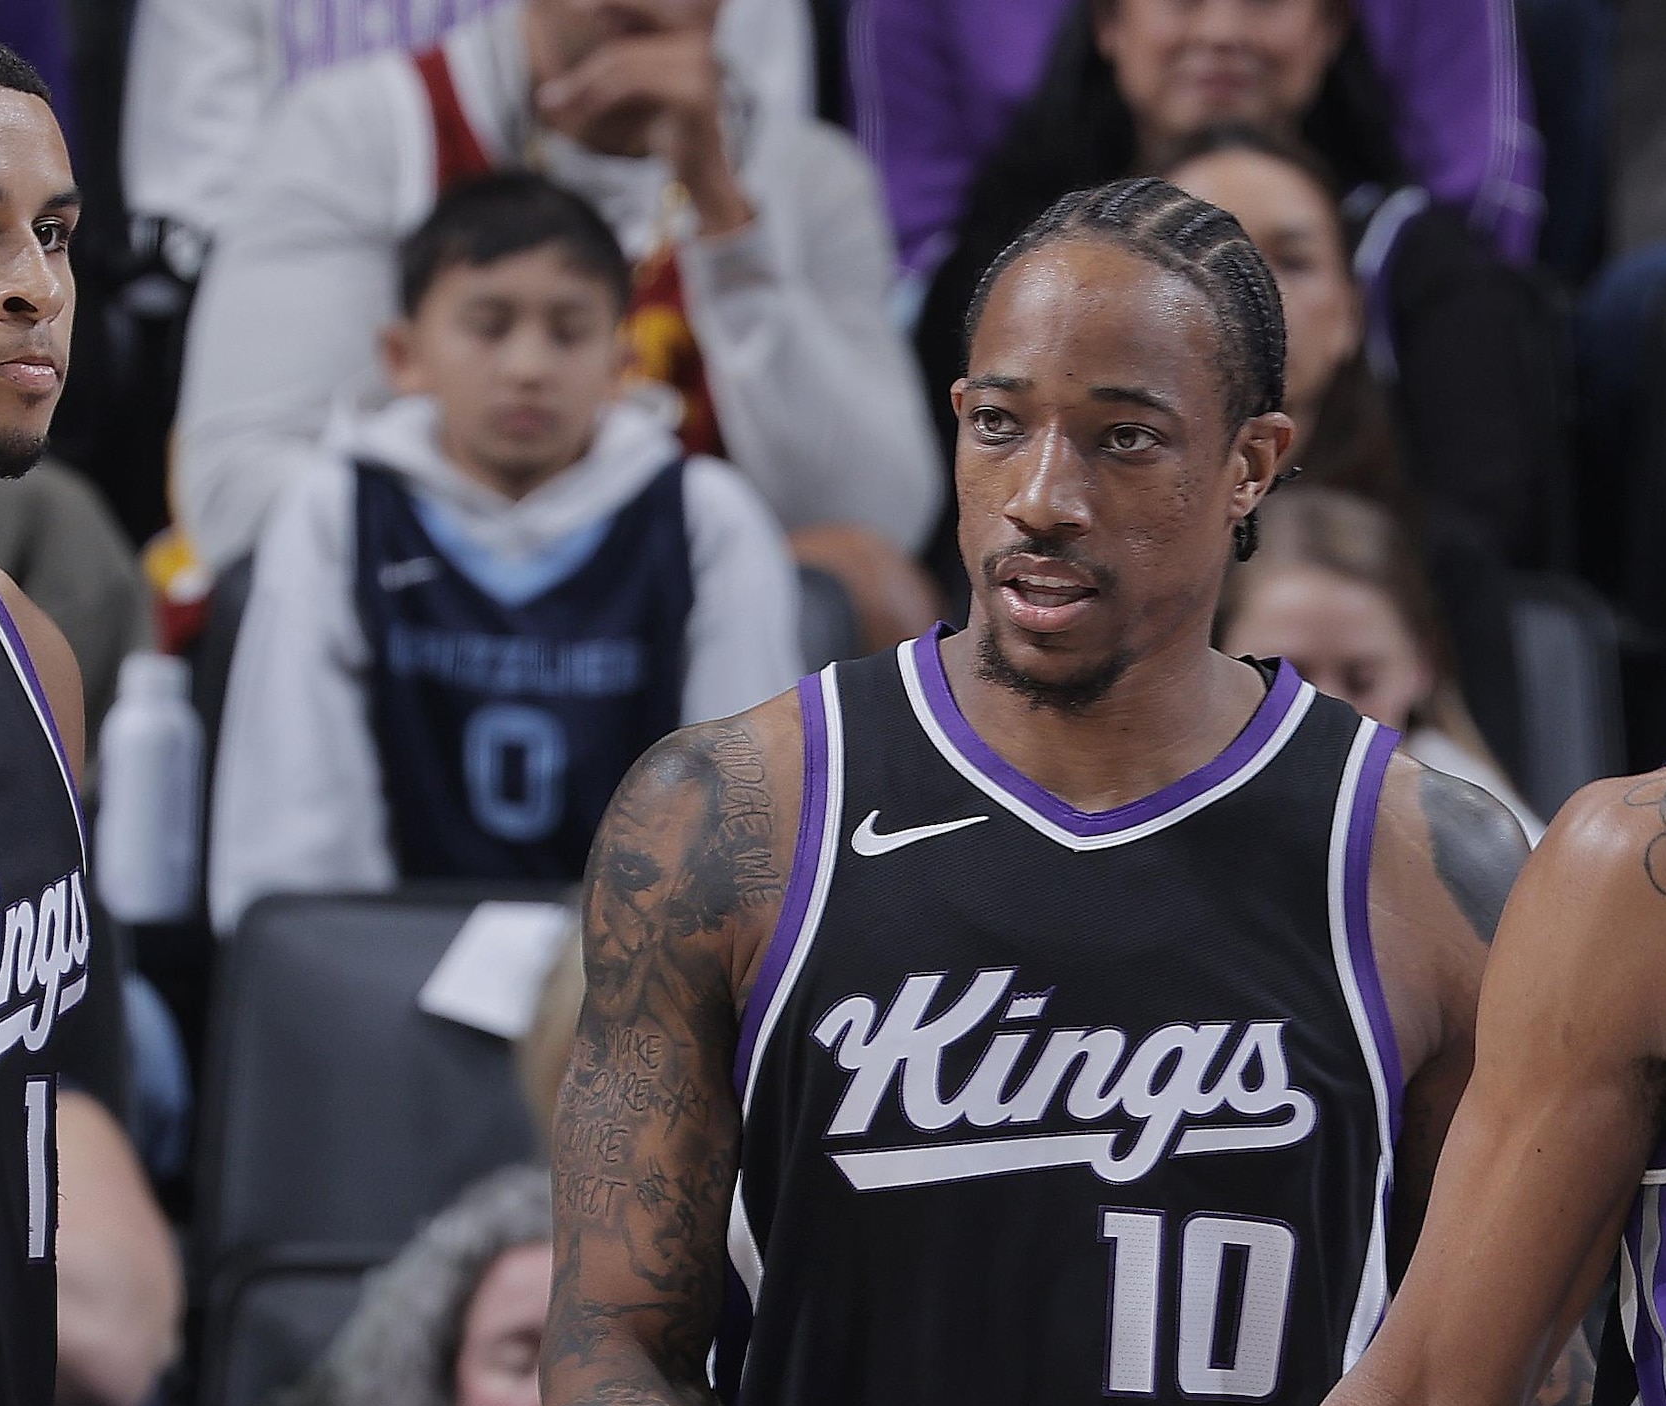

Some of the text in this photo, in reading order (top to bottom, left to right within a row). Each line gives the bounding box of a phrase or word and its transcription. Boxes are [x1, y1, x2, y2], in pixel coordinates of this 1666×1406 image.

[461, 702, 571, 843] 0
[809, 966, 1318, 1192] Kings
[1097, 1205, 1298, 1399] 10
